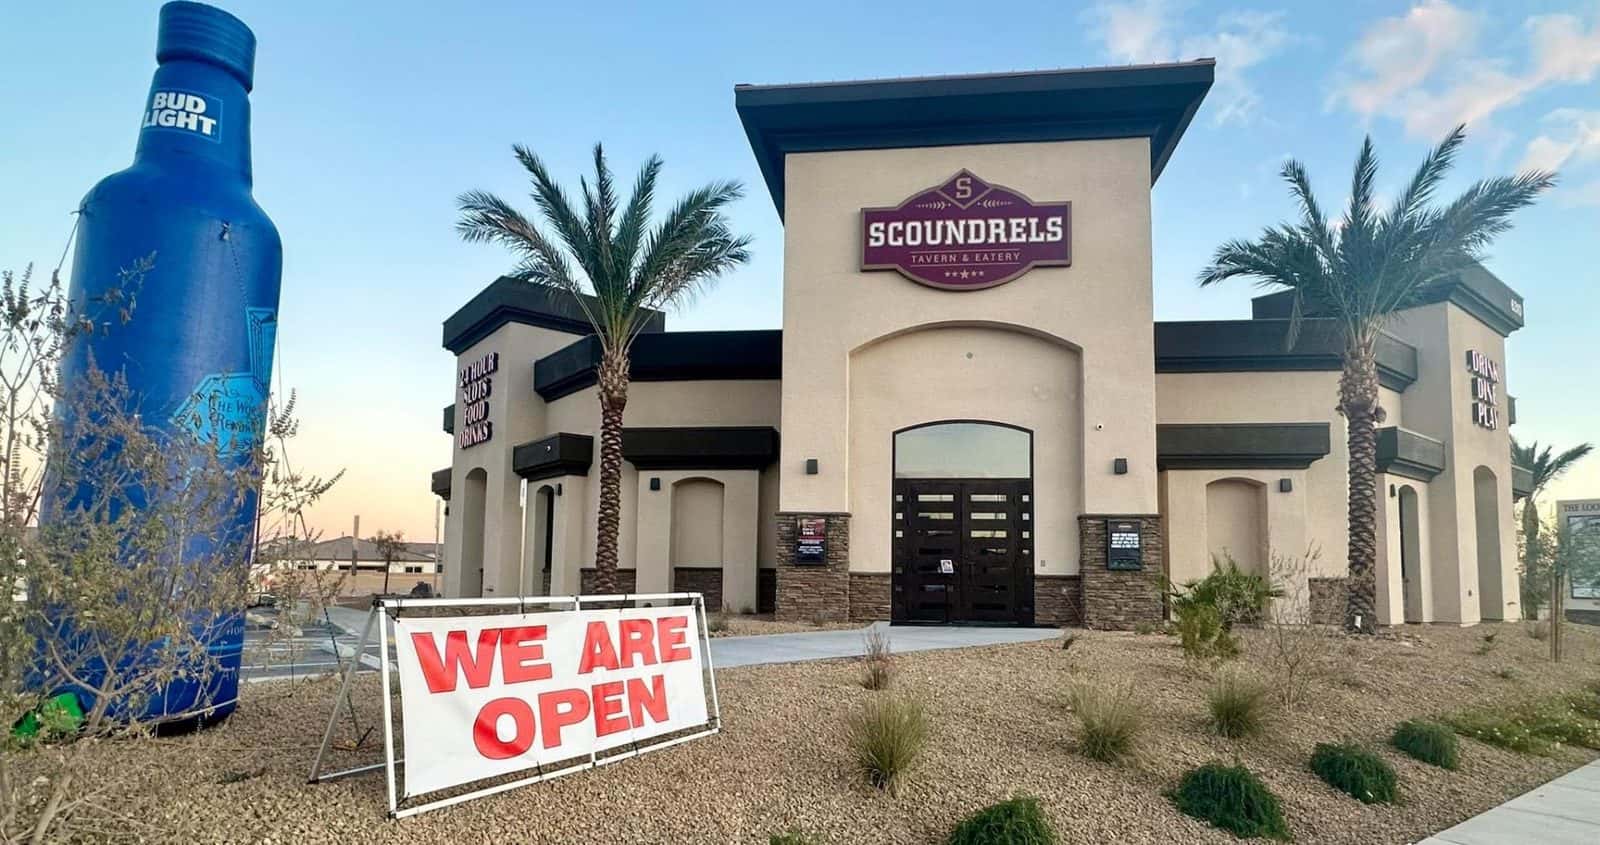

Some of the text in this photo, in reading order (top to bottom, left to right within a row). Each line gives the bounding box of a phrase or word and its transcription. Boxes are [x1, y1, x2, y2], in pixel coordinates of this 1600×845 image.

[152, 92, 206, 113] BUD
[142, 109, 217, 136] LIGHT
[955, 177, 972, 199] S
[868, 215, 1064, 247] SCOUNDRELS
[911, 251, 1021, 264] TAVERN & EATERY
[471, 352, 496, 380] HOUR
[1471, 350, 1499, 383] DRINK
[463, 376, 489, 403] SLOTS
[1476, 378, 1498, 406] DINE
[463, 401, 487, 426] FOOD
[1477, 402, 1498, 430] PLAY
[459, 421, 490, 449] DRINKS
[1564, 504, 1579, 512] THE
[409, 616, 693, 694] WE ARE
[473, 675, 670, 760] OPEN
